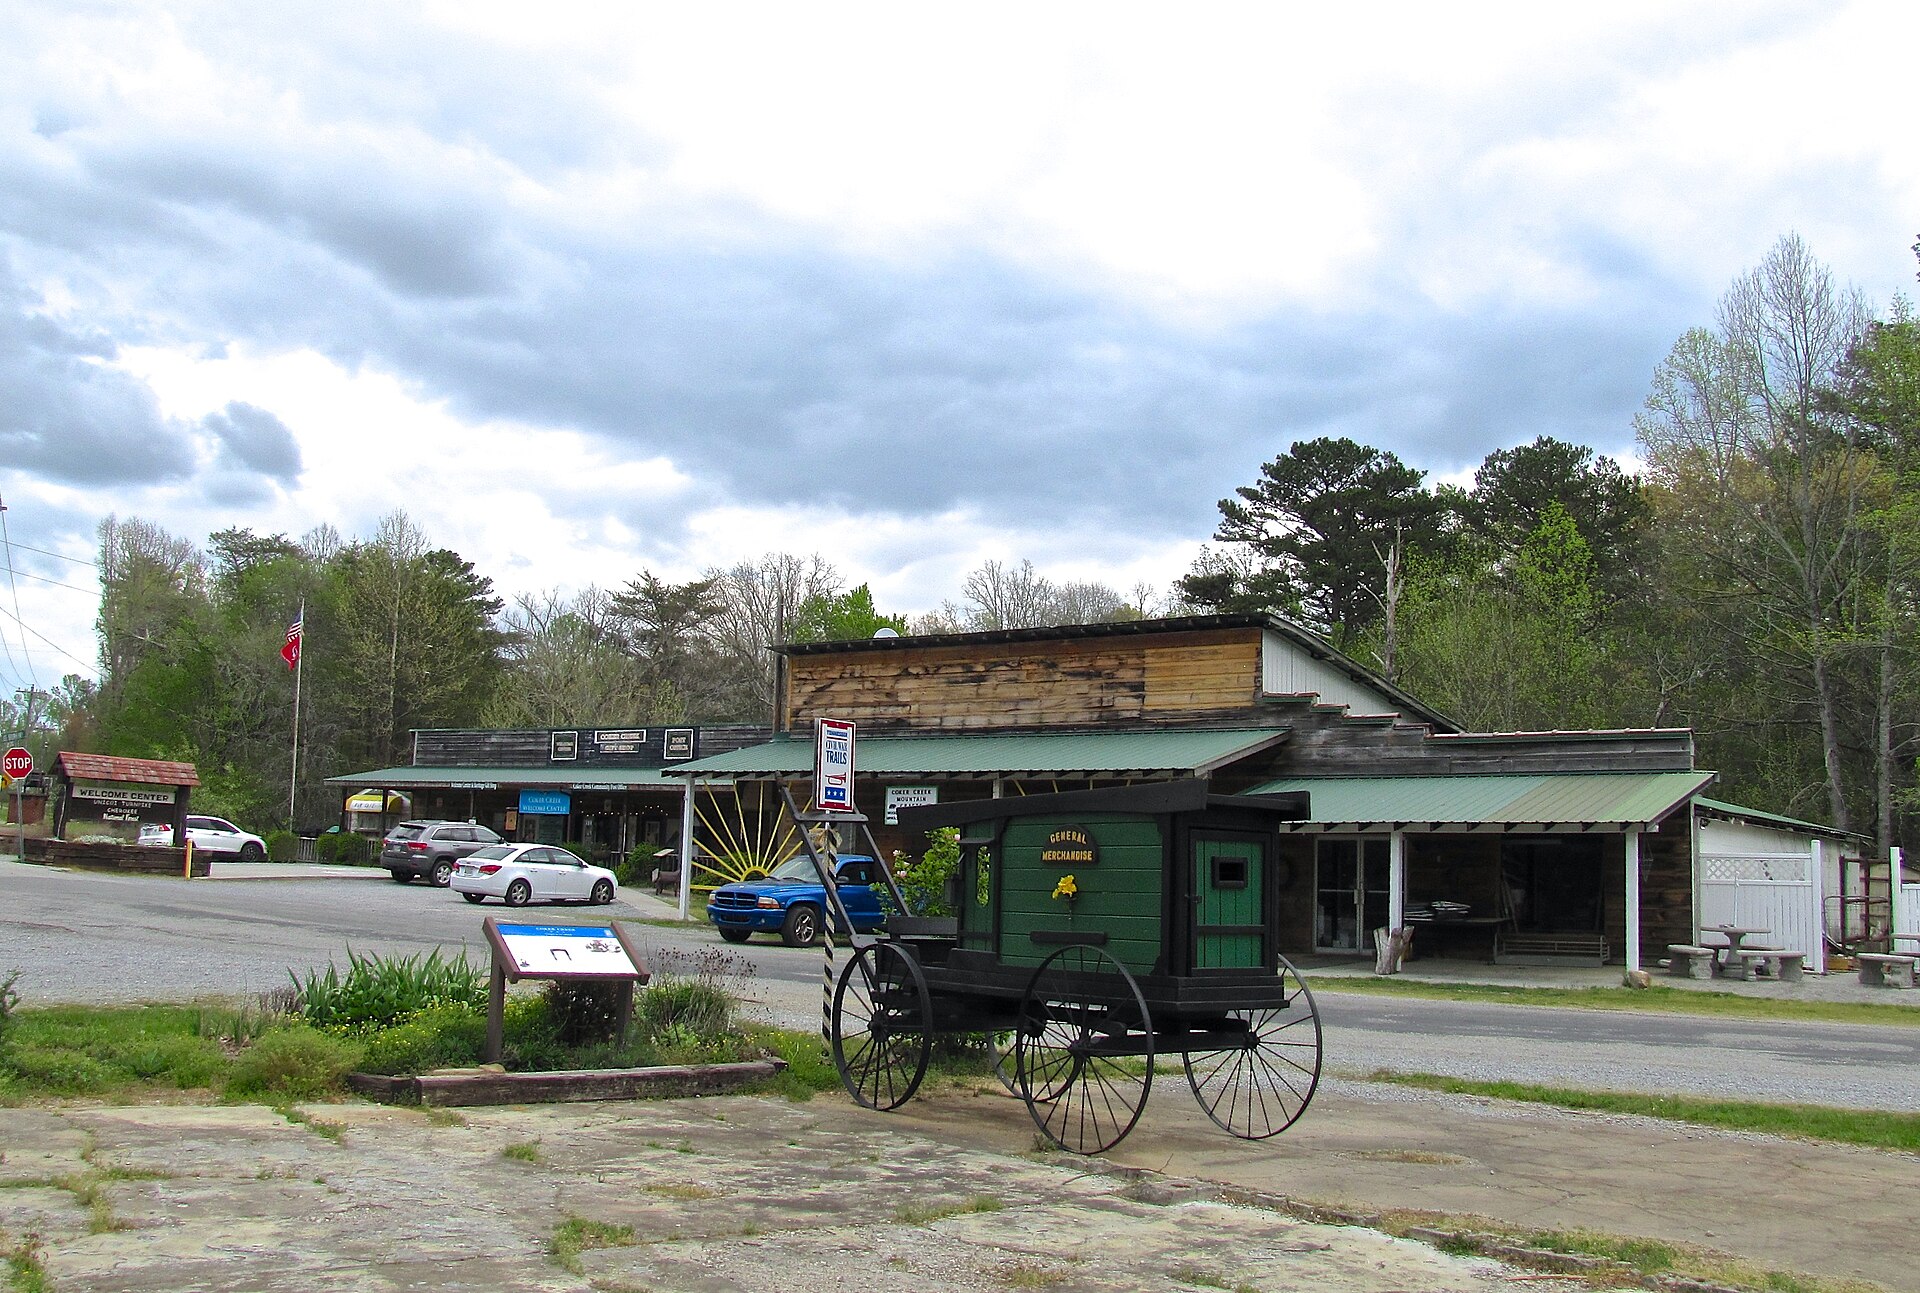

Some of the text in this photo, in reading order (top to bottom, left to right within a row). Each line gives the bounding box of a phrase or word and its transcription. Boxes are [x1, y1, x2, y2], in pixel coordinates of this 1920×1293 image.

[5, 757, 31, 769] STOP
[826, 750, 848, 765] TRAILS
[80, 788, 169, 802] WELCOME CENTER
[107, 807, 138, 815] CHEROKEE
[1050, 830, 1087, 845] GENERAL
[1042, 850, 1093, 861] MERCHANDISE
